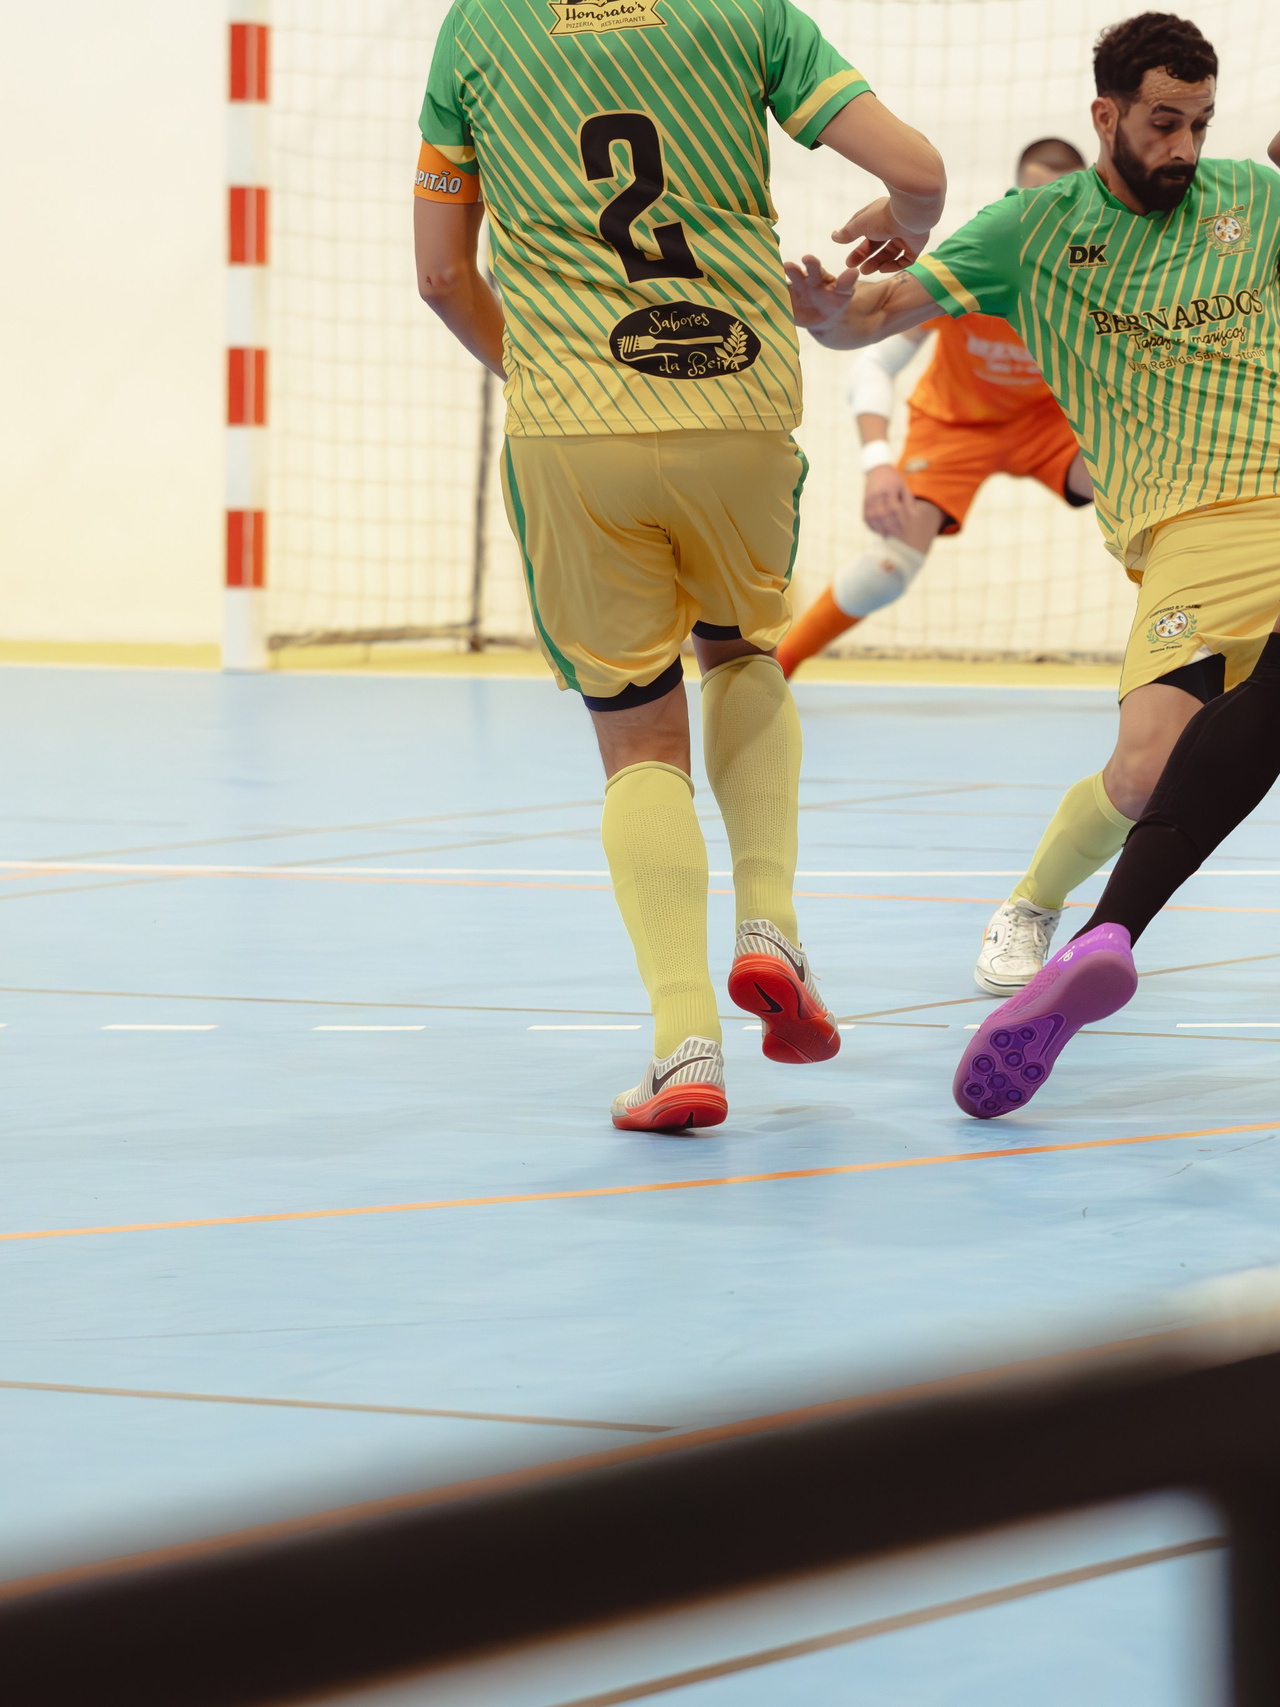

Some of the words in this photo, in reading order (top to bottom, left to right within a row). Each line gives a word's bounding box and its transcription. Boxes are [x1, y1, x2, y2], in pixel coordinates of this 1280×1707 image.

[565, 1, 647, 21] Honorato's
[565, 21, 595, 29] PIZZERIA
[415, 170, 463, 194] PITÃO
[579, 112, 705, 284] 2
[1068, 244, 1108, 264] DK
[648, 310, 711, 335] Sabores
[1088, 289, 1264, 336] BERNARDOS
[659, 353, 681, 374] da
[687, 351, 741, 377] Beira
[1150, 355, 1176, 370] Real
[1179, 355, 1194, 365] de
